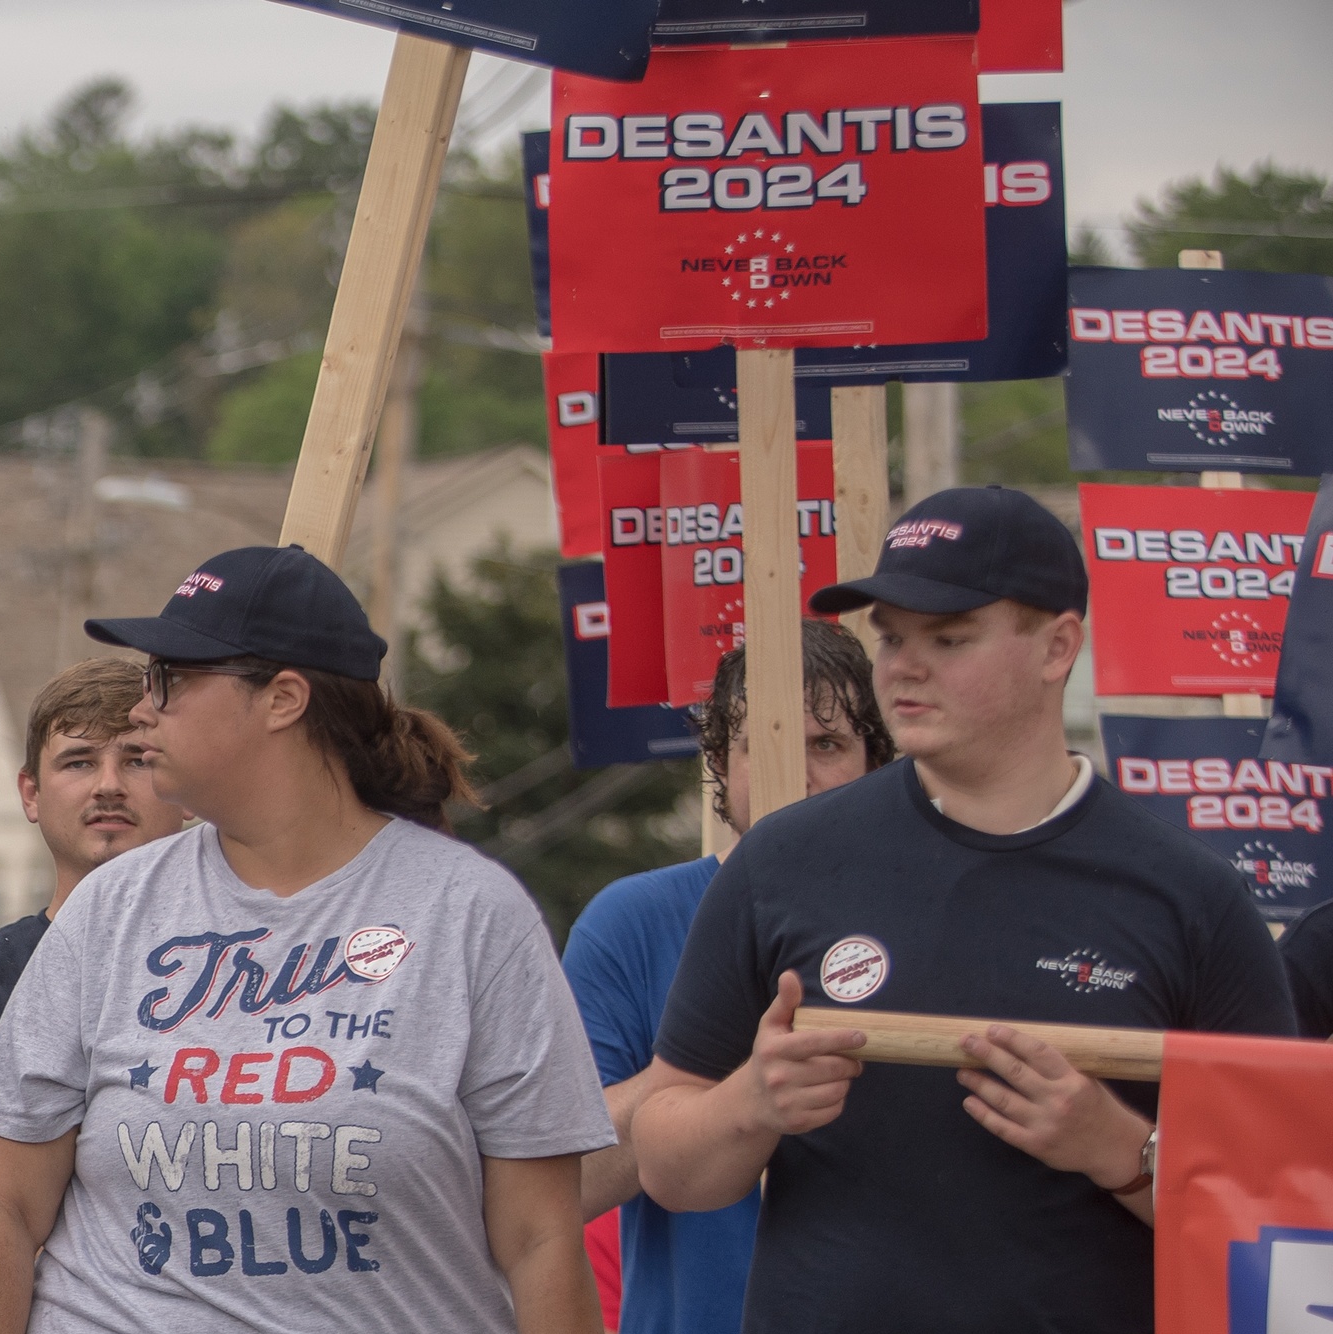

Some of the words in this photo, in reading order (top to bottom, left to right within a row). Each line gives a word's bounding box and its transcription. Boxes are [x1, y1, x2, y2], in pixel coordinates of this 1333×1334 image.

[565, 104, 968, 159] DESANTIS
[661, 161, 866, 211] 2024
[681, 256, 767, 273] NEVER
[775, 254, 847, 271] BACK
[750, 271, 831, 289] DOWN
[1069, 307, 1333, 349] DESANTIS
[1140, 345, 1283, 381] 2024
[1157, 408, 1222, 423] NEVER
[1223, 410, 1274, 424] BACK
[1208, 420, 1265, 435] DOWN
[885, 523, 960, 541] DESANTIS
[889, 535, 929, 550] 2024
[1094, 527, 1306, 565] DESANT
[183, 571, 222, 593] ANTIS
[1165, 566, 1295, 600] 2024
[1247, 632, 1283, 643] BAC
[1117, 756, 1333, 797] DESANT
[1187, 794, 1324, 833] 2024
[1269, 860, 1317, 878] BACK
[347, 938, 405, 963] DESANTIS
[137, 925, 415, 1033] Tru
[1036, 960, 1090, 976] NEVER
[1092, 967, 1134, 982] BACK
[1078, 975, 1125, 990] DOWN
[265, 1013, 311, 1043] TO
[326, 1009, 394, 1040] THE
[163, 1046, 337, 1105] RED
[117, 1121, 382, 1197] WHITE
[130, 1201, 173, 1276] &
[185, 1207, 380, 1276] BLUE
